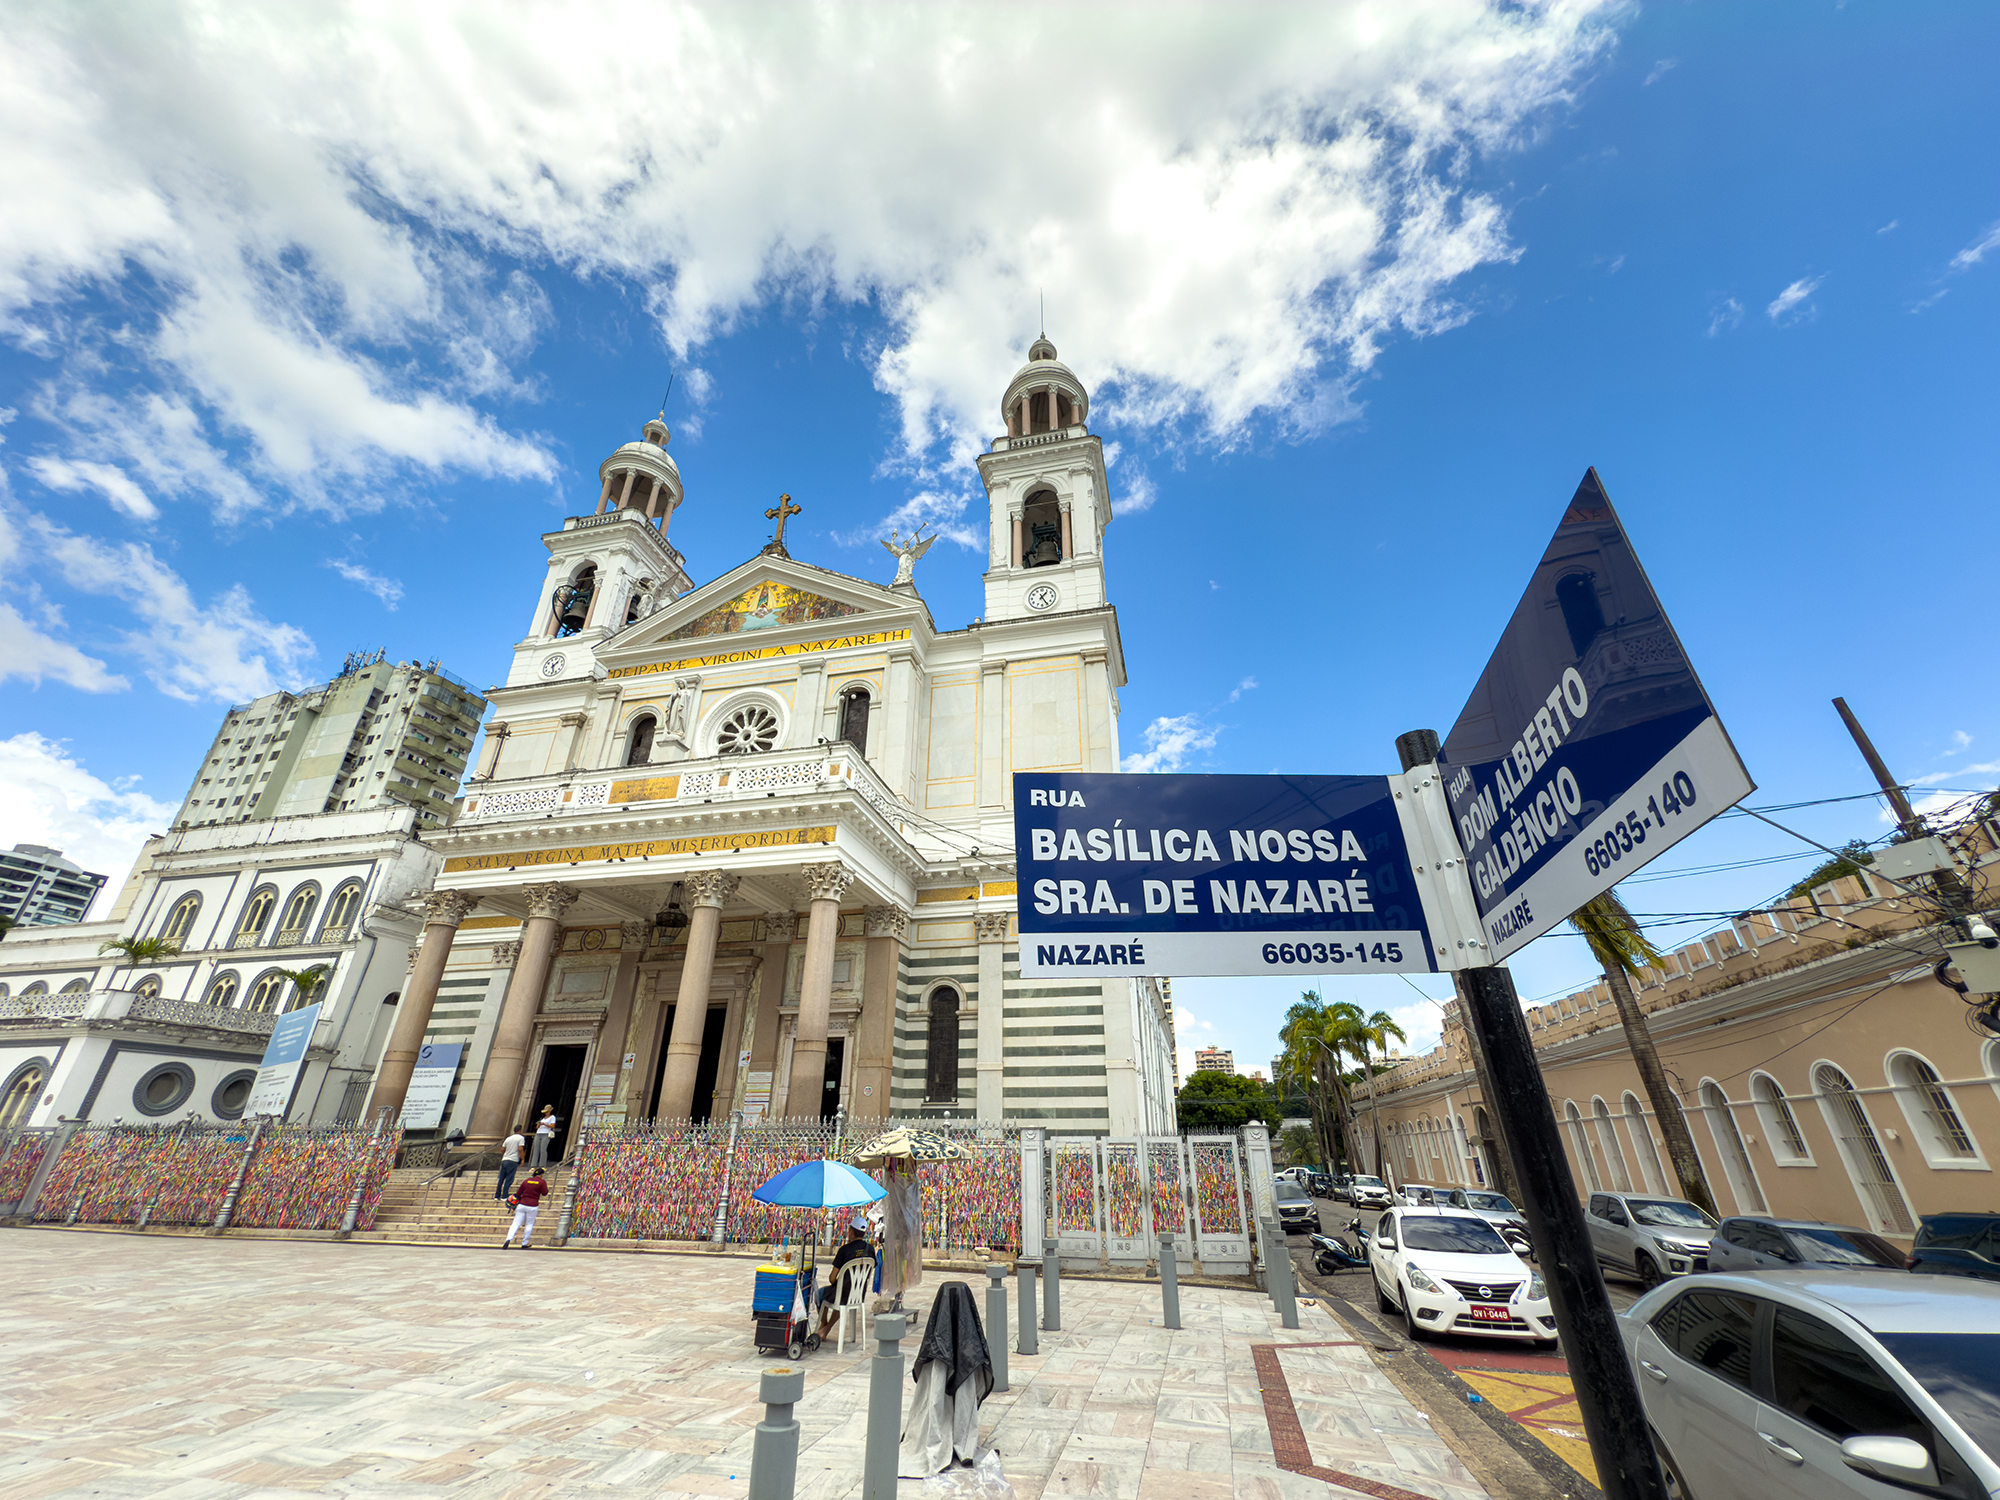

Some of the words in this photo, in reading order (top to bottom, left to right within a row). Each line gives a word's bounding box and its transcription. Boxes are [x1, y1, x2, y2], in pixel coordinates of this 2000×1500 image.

[612, 659, 687, 679] DEIPARÆ
[700, 649, 762, 667] VIRGINI
[773, 645, 787, 657] A
[799, 629, 905, 654] NAZARETH
[1460, 784, 1500, 853] DOM
[1495, 667, 1588, 812] ALBERTO
[1030, 789, 1087, 808] RUA
[1450, 766, 1471, 803] RUA
[1031, 818, 1221, 862] BASÍLICA
[1229, 829, 1368, 862] NOSSA
[1475, 766, 1582, 899] GALDÊNCIO
[1584, 770, 1697, 877] 66035-140
[464, 854, 515, 870] SALVE
[523, 849, 586, 865] REGINA
[599, 842, 656, 860] MATER
[668, 829, 809, 852] MISERICORDIÆ
[1033, 878, 1130, 915] SRA.
[1143, 879, 1199, 914] DE
[1210, 869, 1375, 914] NAZARÉ
[1491, 893, 1535, 946] NAZARÉ
[1037, 937, 1146, 966] NAZARÉ
[1262, 942, 1404, 965] 66035-145
